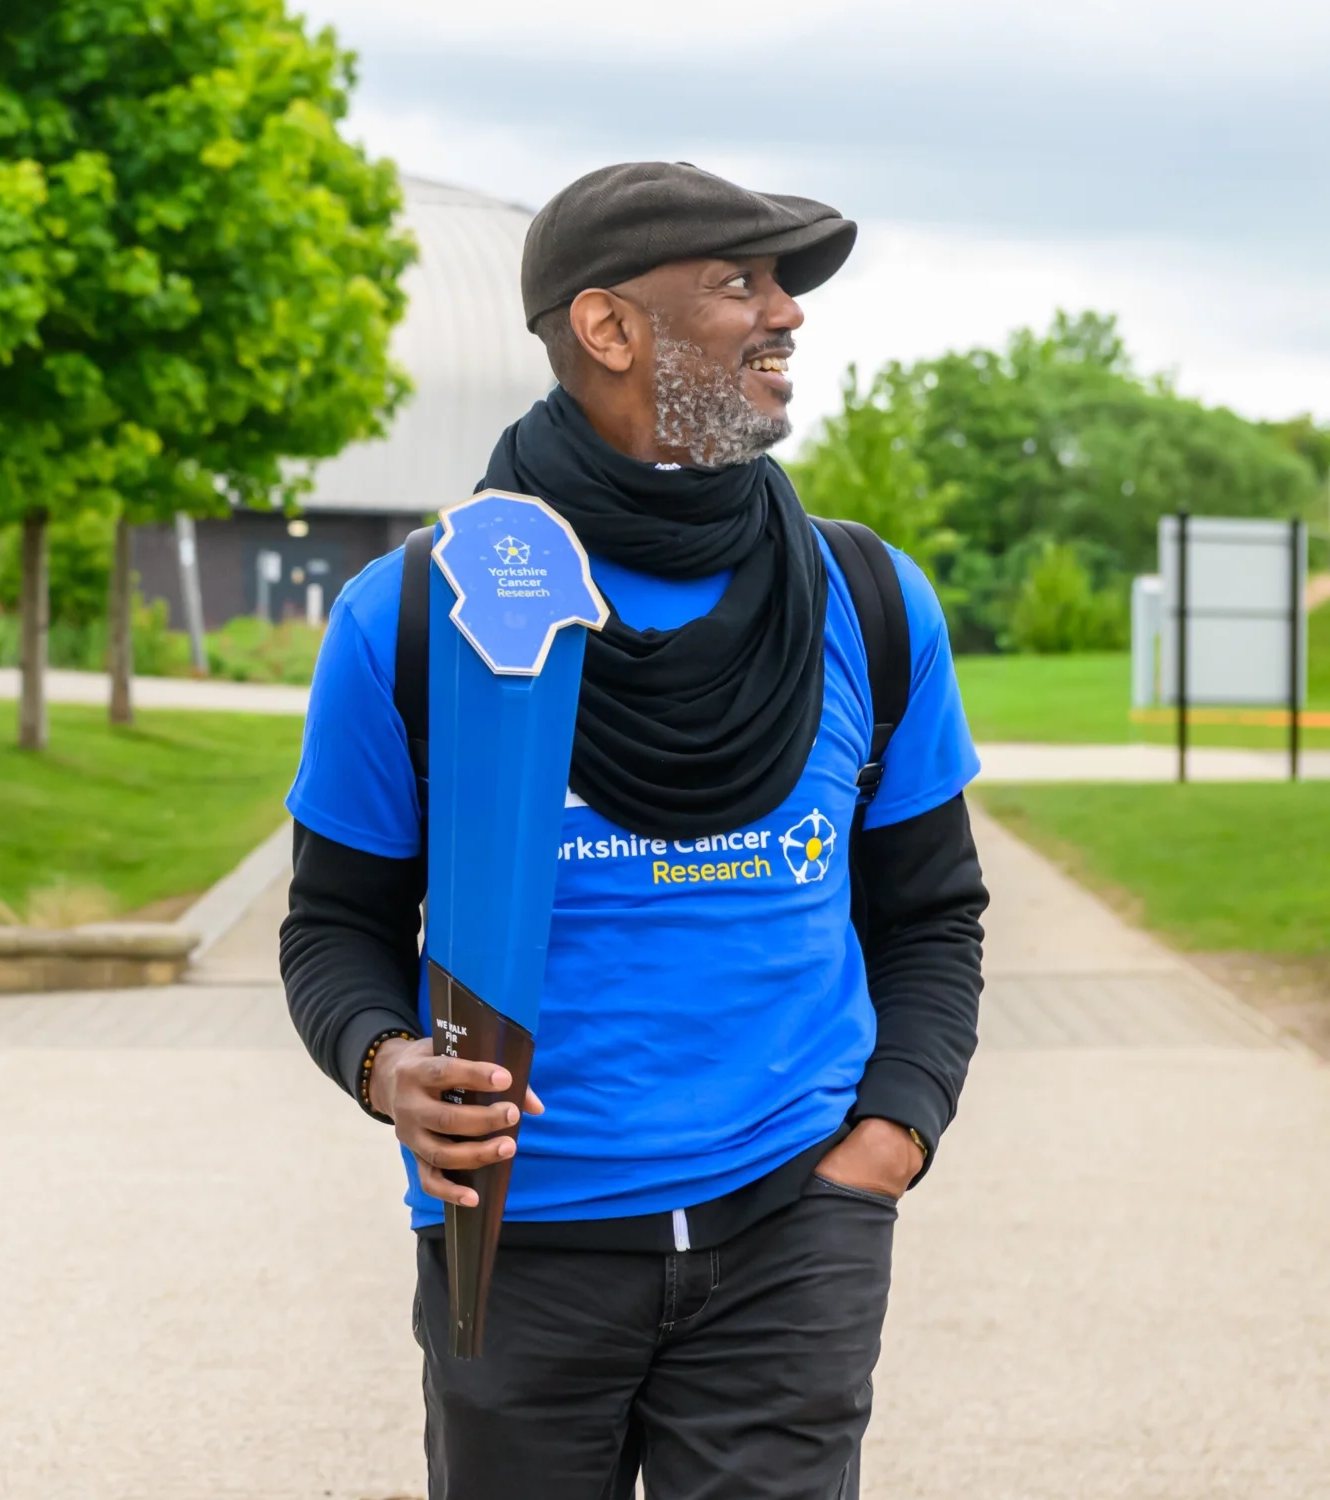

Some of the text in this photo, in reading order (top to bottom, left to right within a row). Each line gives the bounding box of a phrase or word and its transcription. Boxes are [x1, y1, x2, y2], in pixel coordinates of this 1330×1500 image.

[488, 567, 547, 576] Yorkshire
[498, 578, 542, 587] Cancer
[496, 588, 550, 597] Research
[557, 831, 771, 860] rkshire Cancer
[652, 855, 772, 884] Research
[436, 1018, 448, 1029] WE
